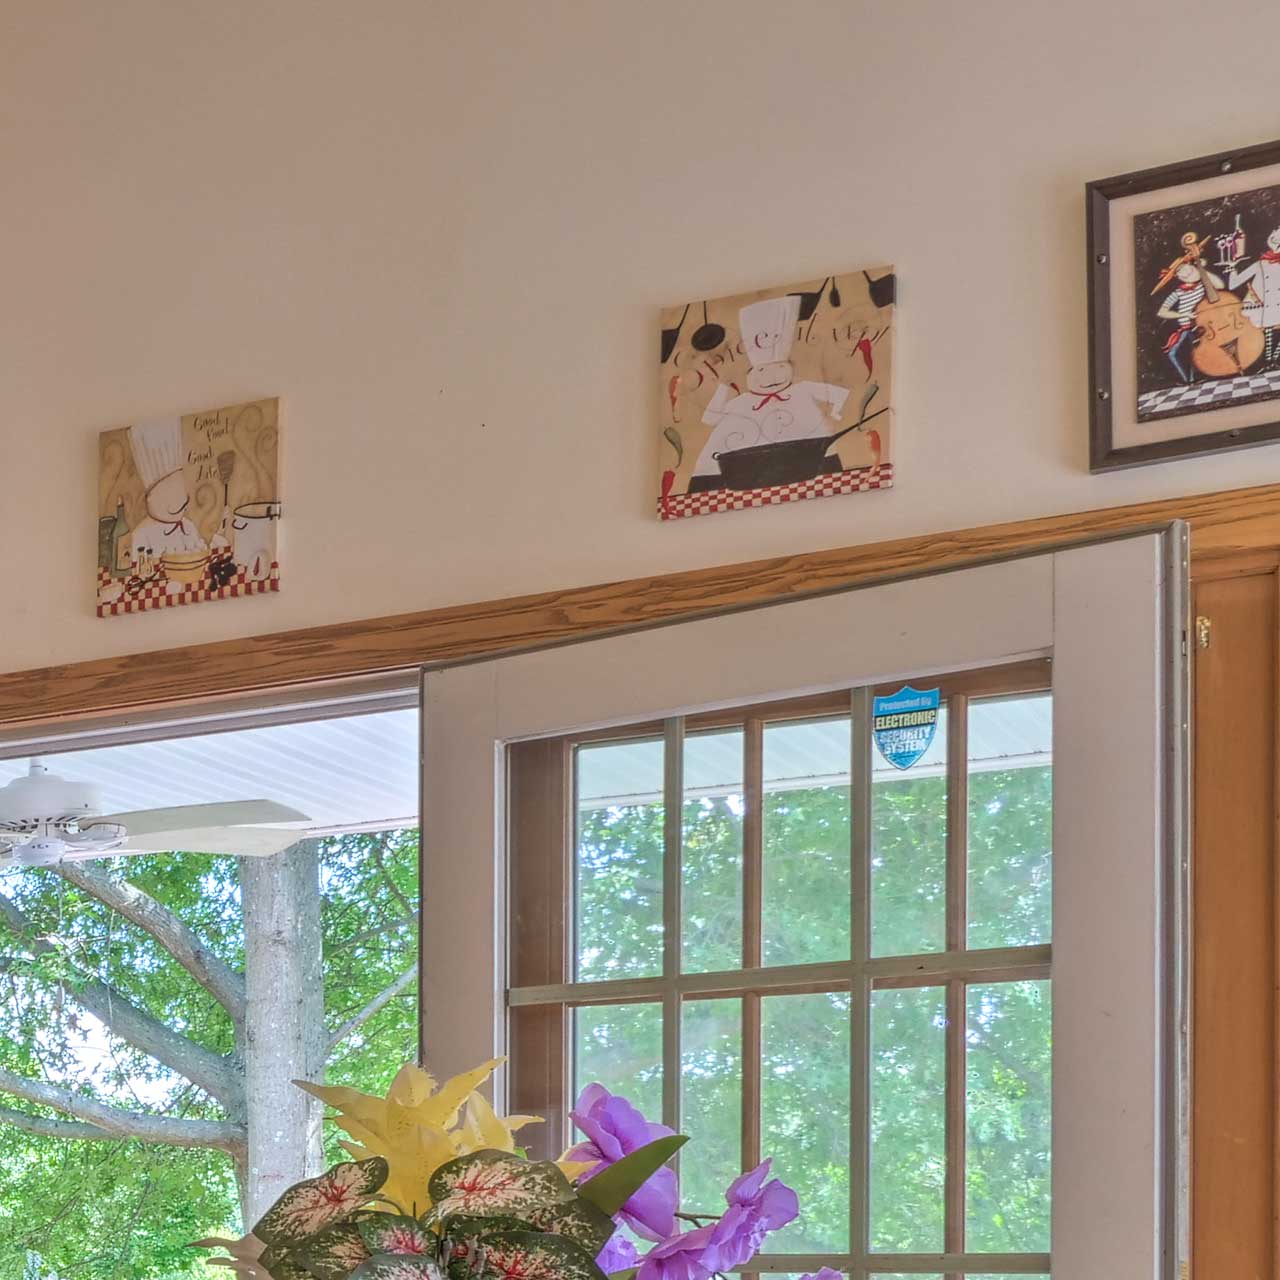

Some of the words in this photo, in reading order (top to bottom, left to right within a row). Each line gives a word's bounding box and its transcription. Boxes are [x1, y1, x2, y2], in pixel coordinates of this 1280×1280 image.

[193, 410, 219, 430] Good
[187, 446, 213, 464] Good
[875, 710, 935, 729] ELECTRONIC
[880, 726, 931, 743] SECURITY
